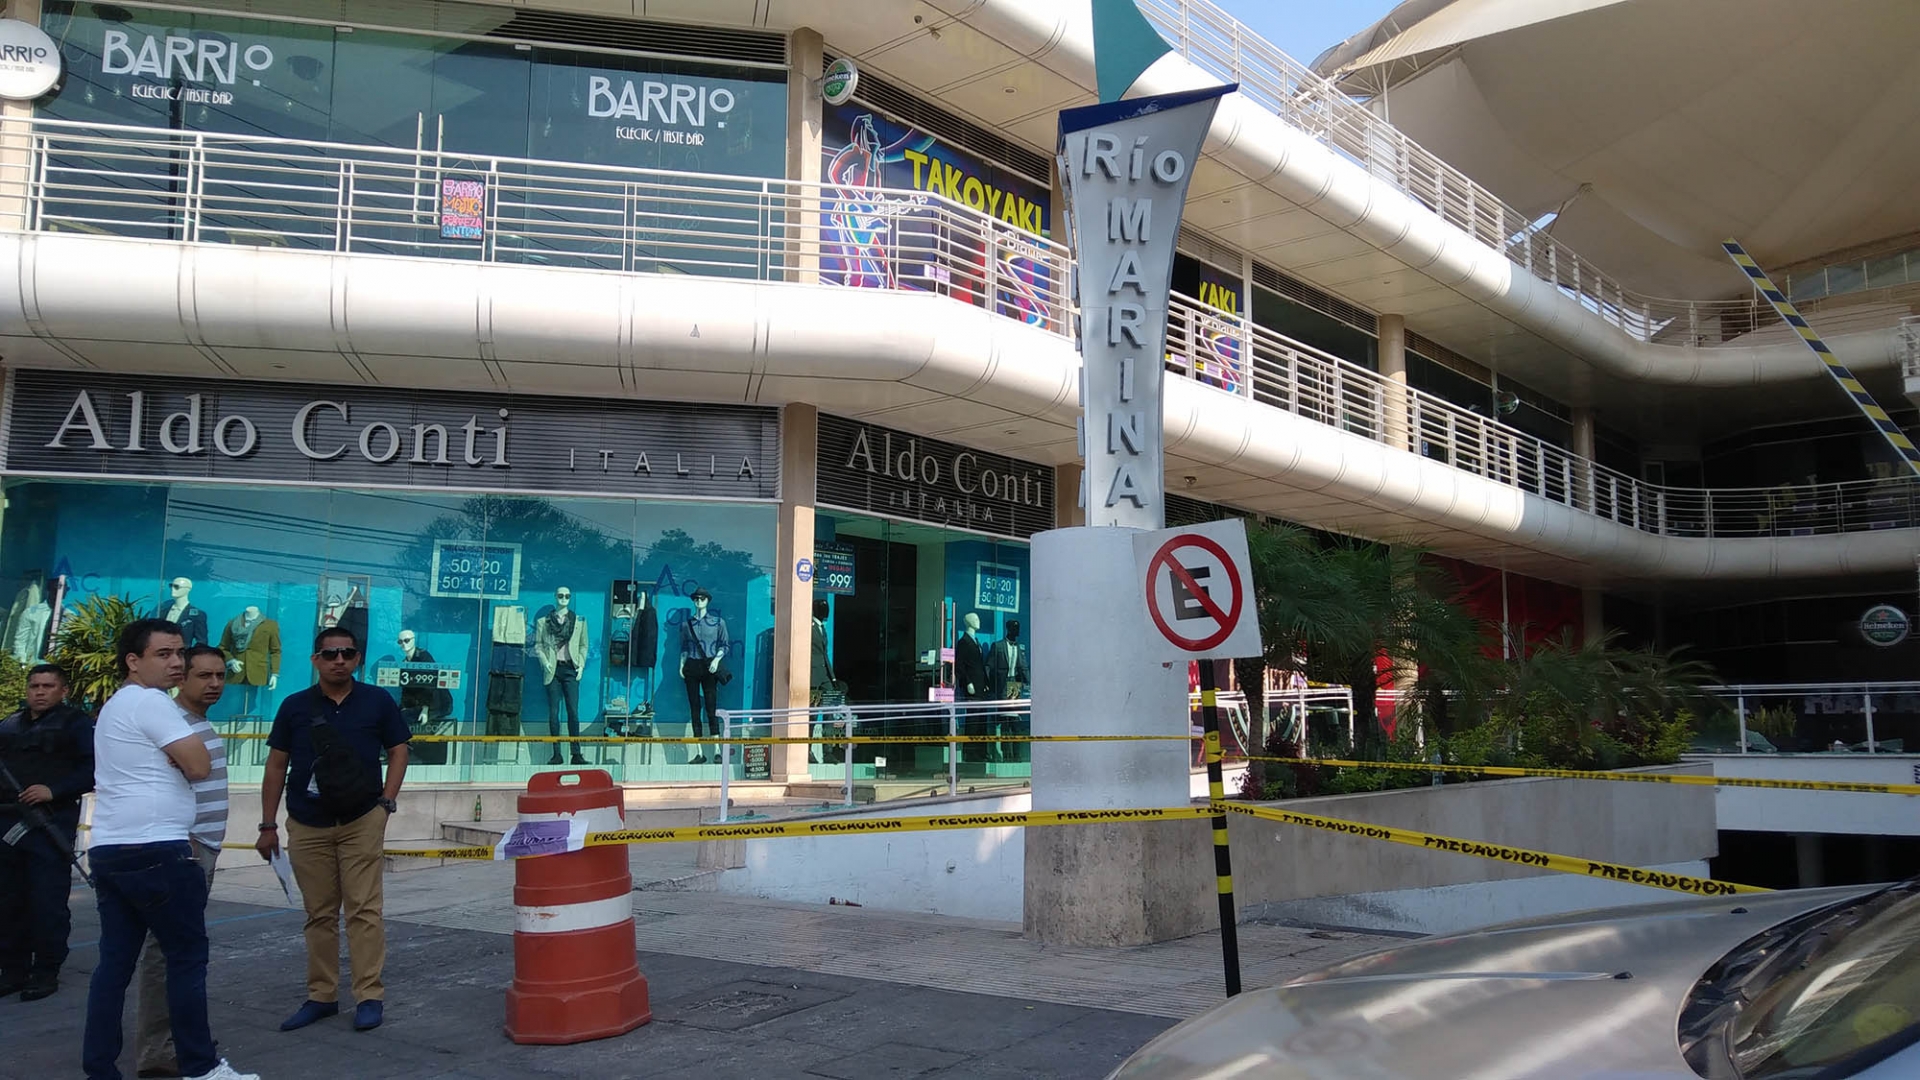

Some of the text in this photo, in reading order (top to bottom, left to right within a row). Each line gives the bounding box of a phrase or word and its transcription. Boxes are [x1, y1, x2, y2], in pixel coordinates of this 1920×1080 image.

[132, 84, 175, 100] ECLECTIC
[185, 89, 210, 103] TASTE
[212, 92, 233, 105] BAR
[616, 126, 653, 142] ECLECTIC
[663, 130, 684, 144] TASTE
[686, 131, 704, 146] BAR
[904, 149, 1042, 236] TAKOYAKI
[1106, 198, 1152, 508] MARINA
[45, 389, 511, 466] Aldo Conti
[570, 448, 755, 477] ITALIA
[847, 427, 1044, 508] Aldo Conti
[903, 489, 993, 522] ITALIA
[493, 578, 507, 592] 12
[1170, 566, 1211, 620] E
[1863, 622, 1905, 630] Heineken
[1282, 813, 1737, 895] PRECAUCION PRECAUCION PRECAUCION
